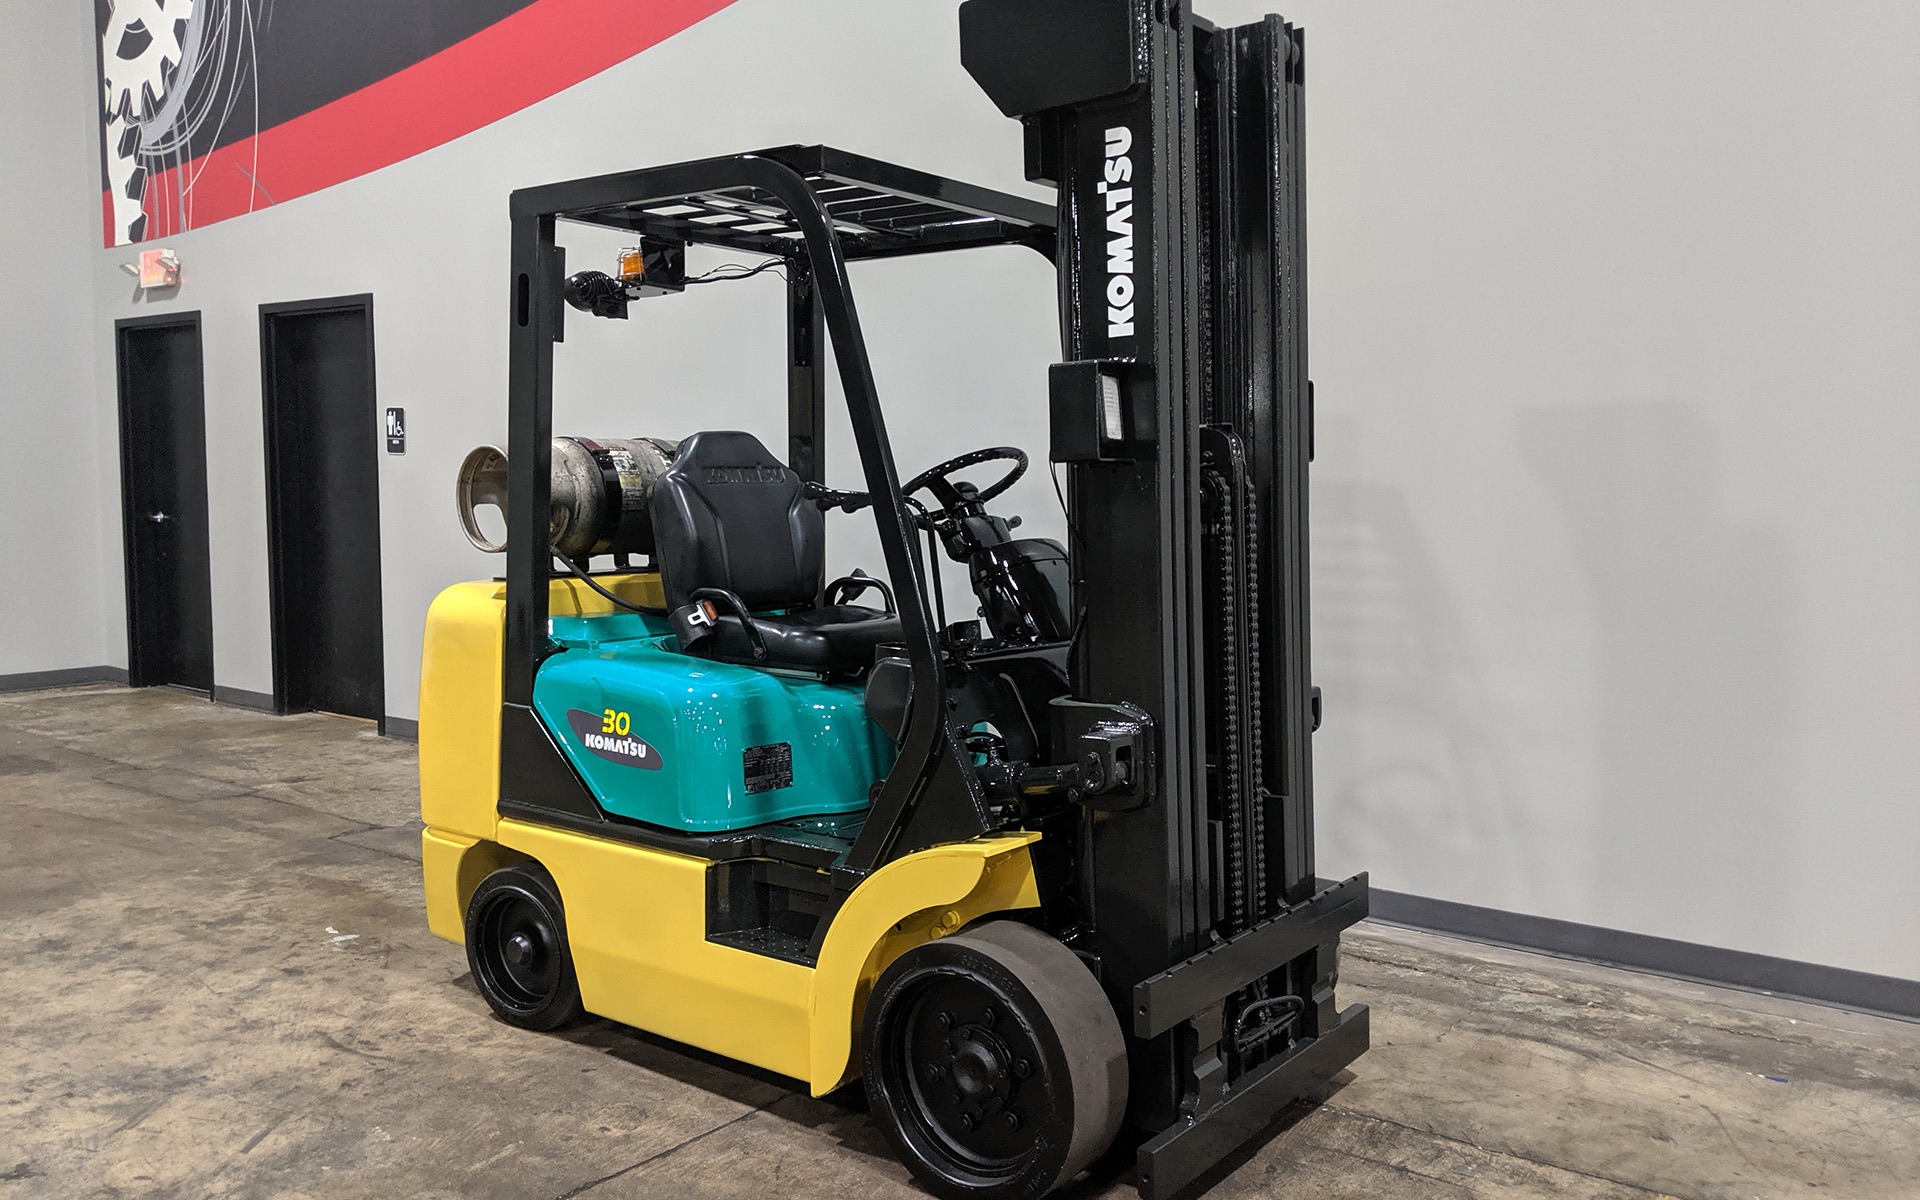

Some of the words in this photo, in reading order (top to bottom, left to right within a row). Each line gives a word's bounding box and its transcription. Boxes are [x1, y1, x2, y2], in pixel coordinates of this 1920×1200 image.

[1097, 126, 1135, 338] KOMATSU
[601, 708, 631, 736] 30
[585, 733, 647, 759] KOMATSU
